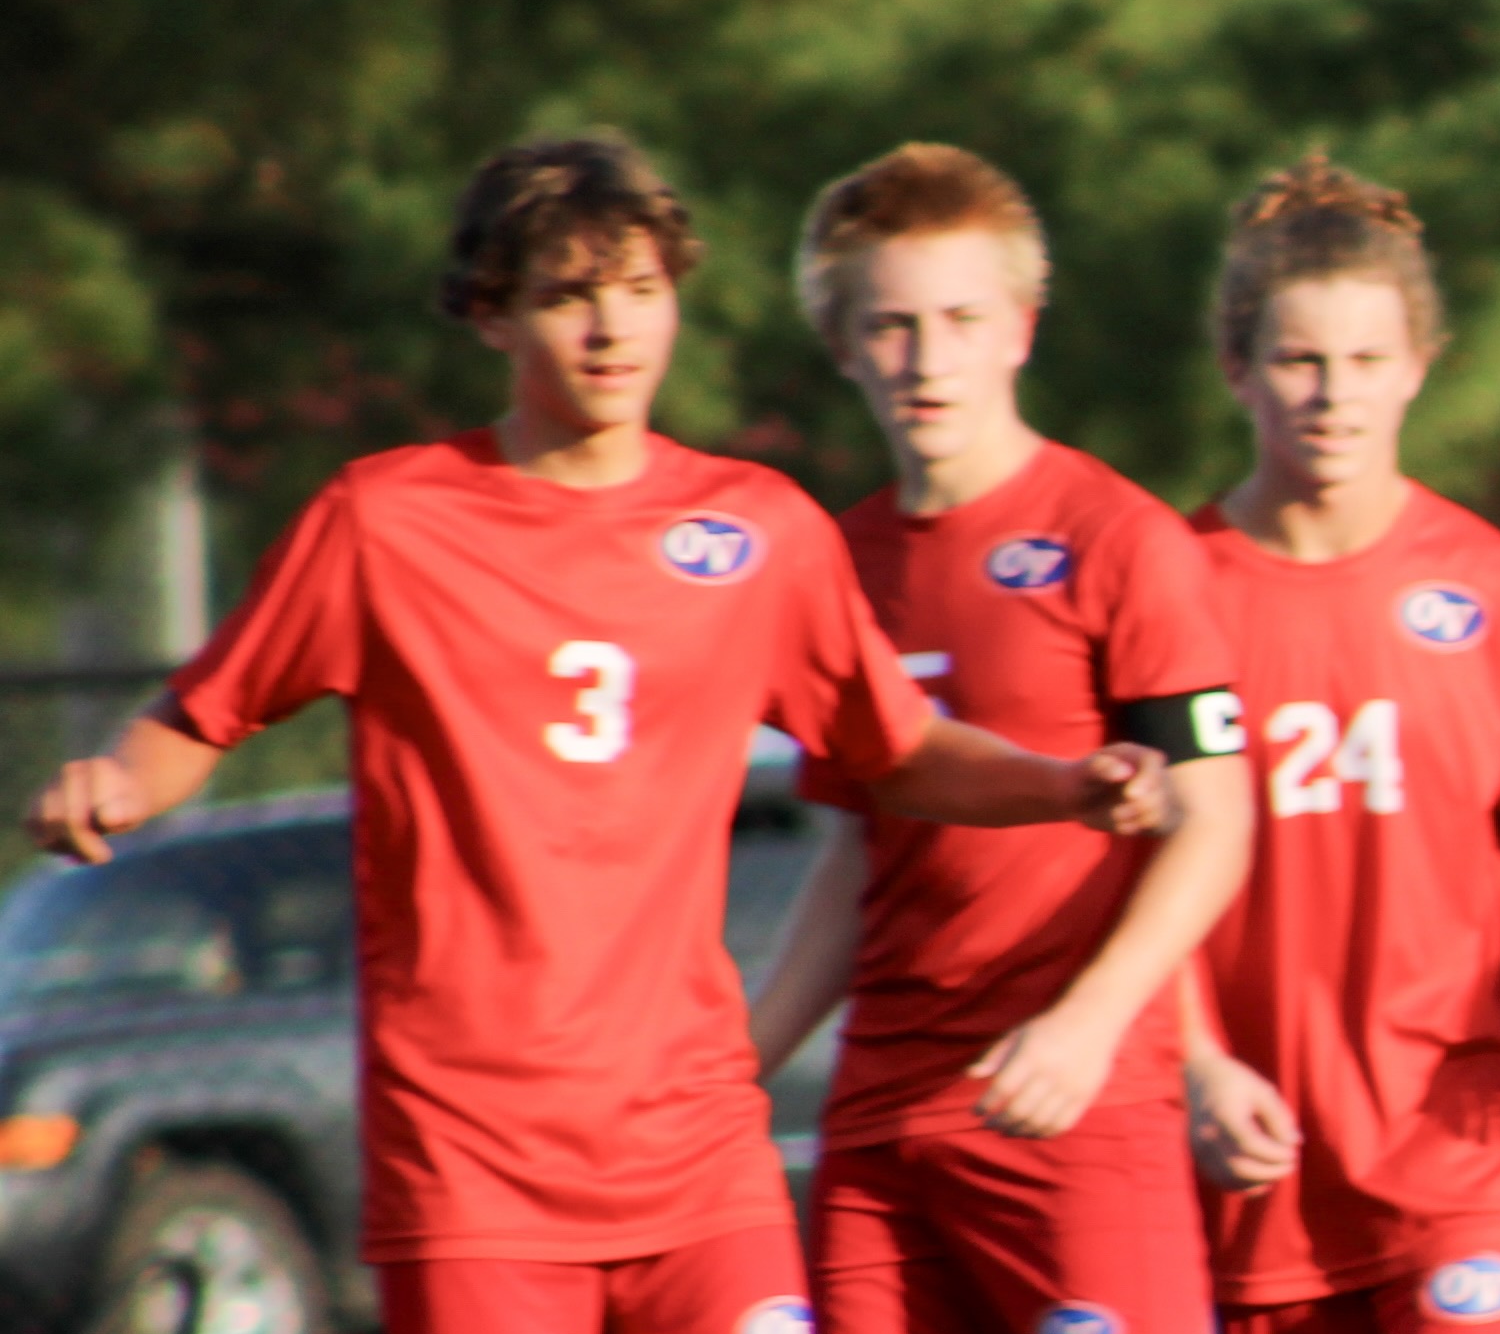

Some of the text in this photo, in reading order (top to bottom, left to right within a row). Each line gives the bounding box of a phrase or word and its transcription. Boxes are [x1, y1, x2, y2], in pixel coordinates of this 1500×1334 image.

[661, 520, 747, 572] OV
[1403, 590, 1479, 640] OV
[542, 639, 634, 763] 3
[1191, 691, 1246, 753] C
[1264, 699, 1404, 819] 24
